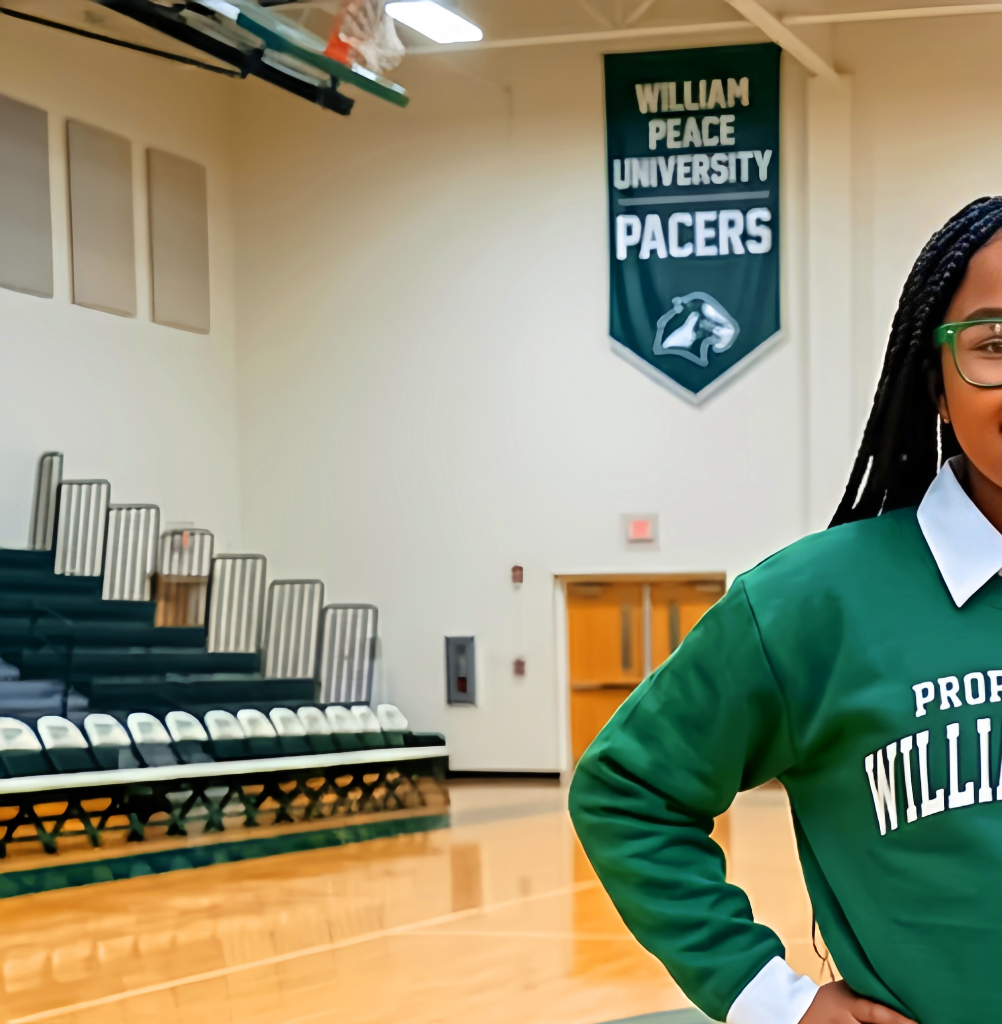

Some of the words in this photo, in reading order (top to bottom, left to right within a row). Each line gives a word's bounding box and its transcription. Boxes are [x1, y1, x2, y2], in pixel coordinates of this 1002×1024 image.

[635, 76, 750, 114] WILLIAM
[648, 114, 736, 150] PEACE
[613, 149, 773, 190] UNIVERSITY
[615, 207, 773, 260] PACERS
